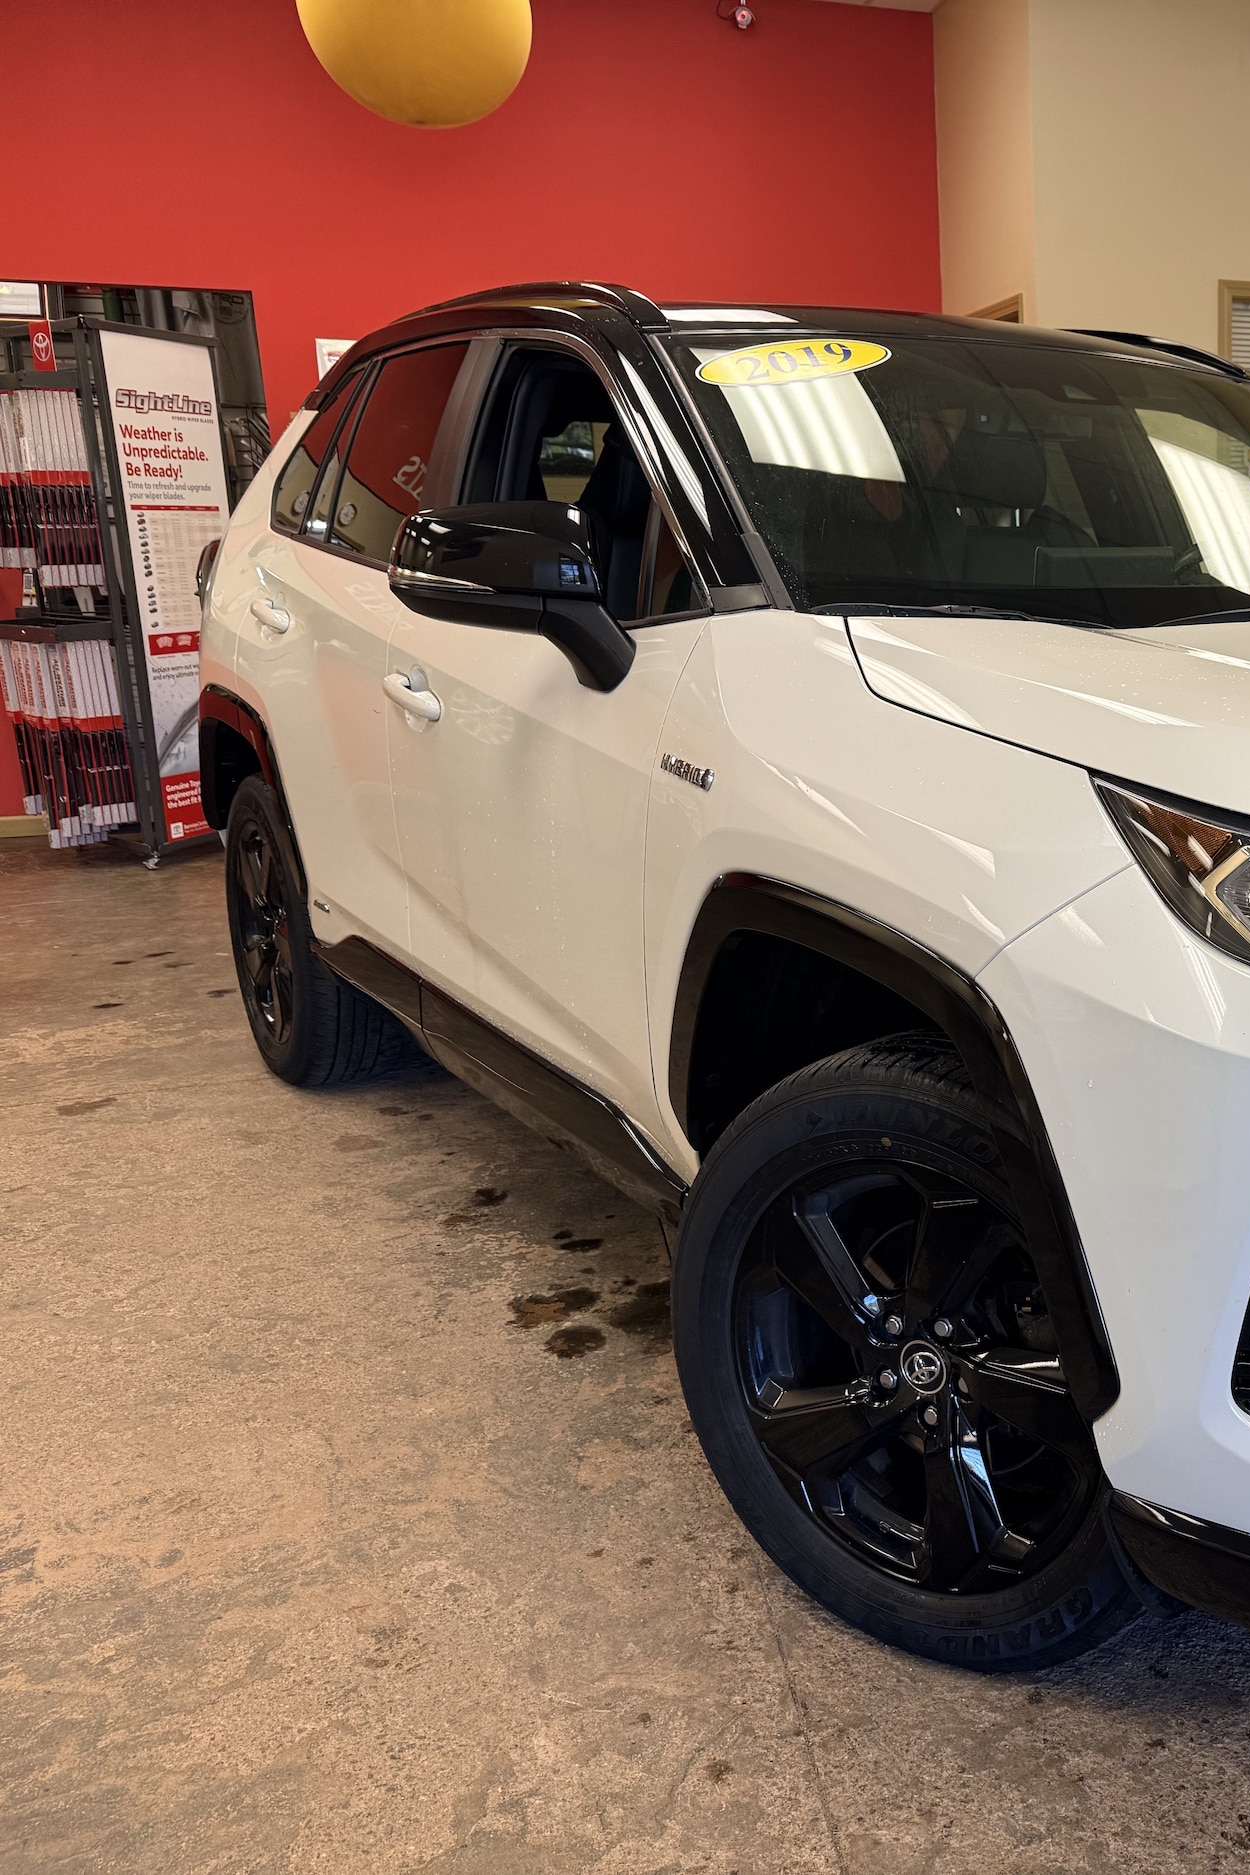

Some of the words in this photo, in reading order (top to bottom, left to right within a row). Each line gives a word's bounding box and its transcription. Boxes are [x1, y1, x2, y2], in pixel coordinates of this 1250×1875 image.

[735, 343, 852, 381] 2019
[116, 389, 212, 416] SightLine
[119, 424, 171, 442] Weather
[173, 428, 183, 442] is
[122, 442, 208, 461] Unpredictable.
[126, 462, 141, 476] Be
[144, 462, 183, 481] Ready!
[128, 481, 144, 490] Time
[152, 481, 174, 490] refresh
[175, 483, 187, 491] and
[187, 484, 211, 493] upgrade
[129, 492, 144, 500] your
[145, 493, 162, 501] wiper
[164, 492, 185, 500] blades.
[166, 783, 190, 792] Genuine
[167, 788, 198, 801] engineered
[178, 799, 190, 807] best
[836, 1099, 1001, 1165] DUNLO
